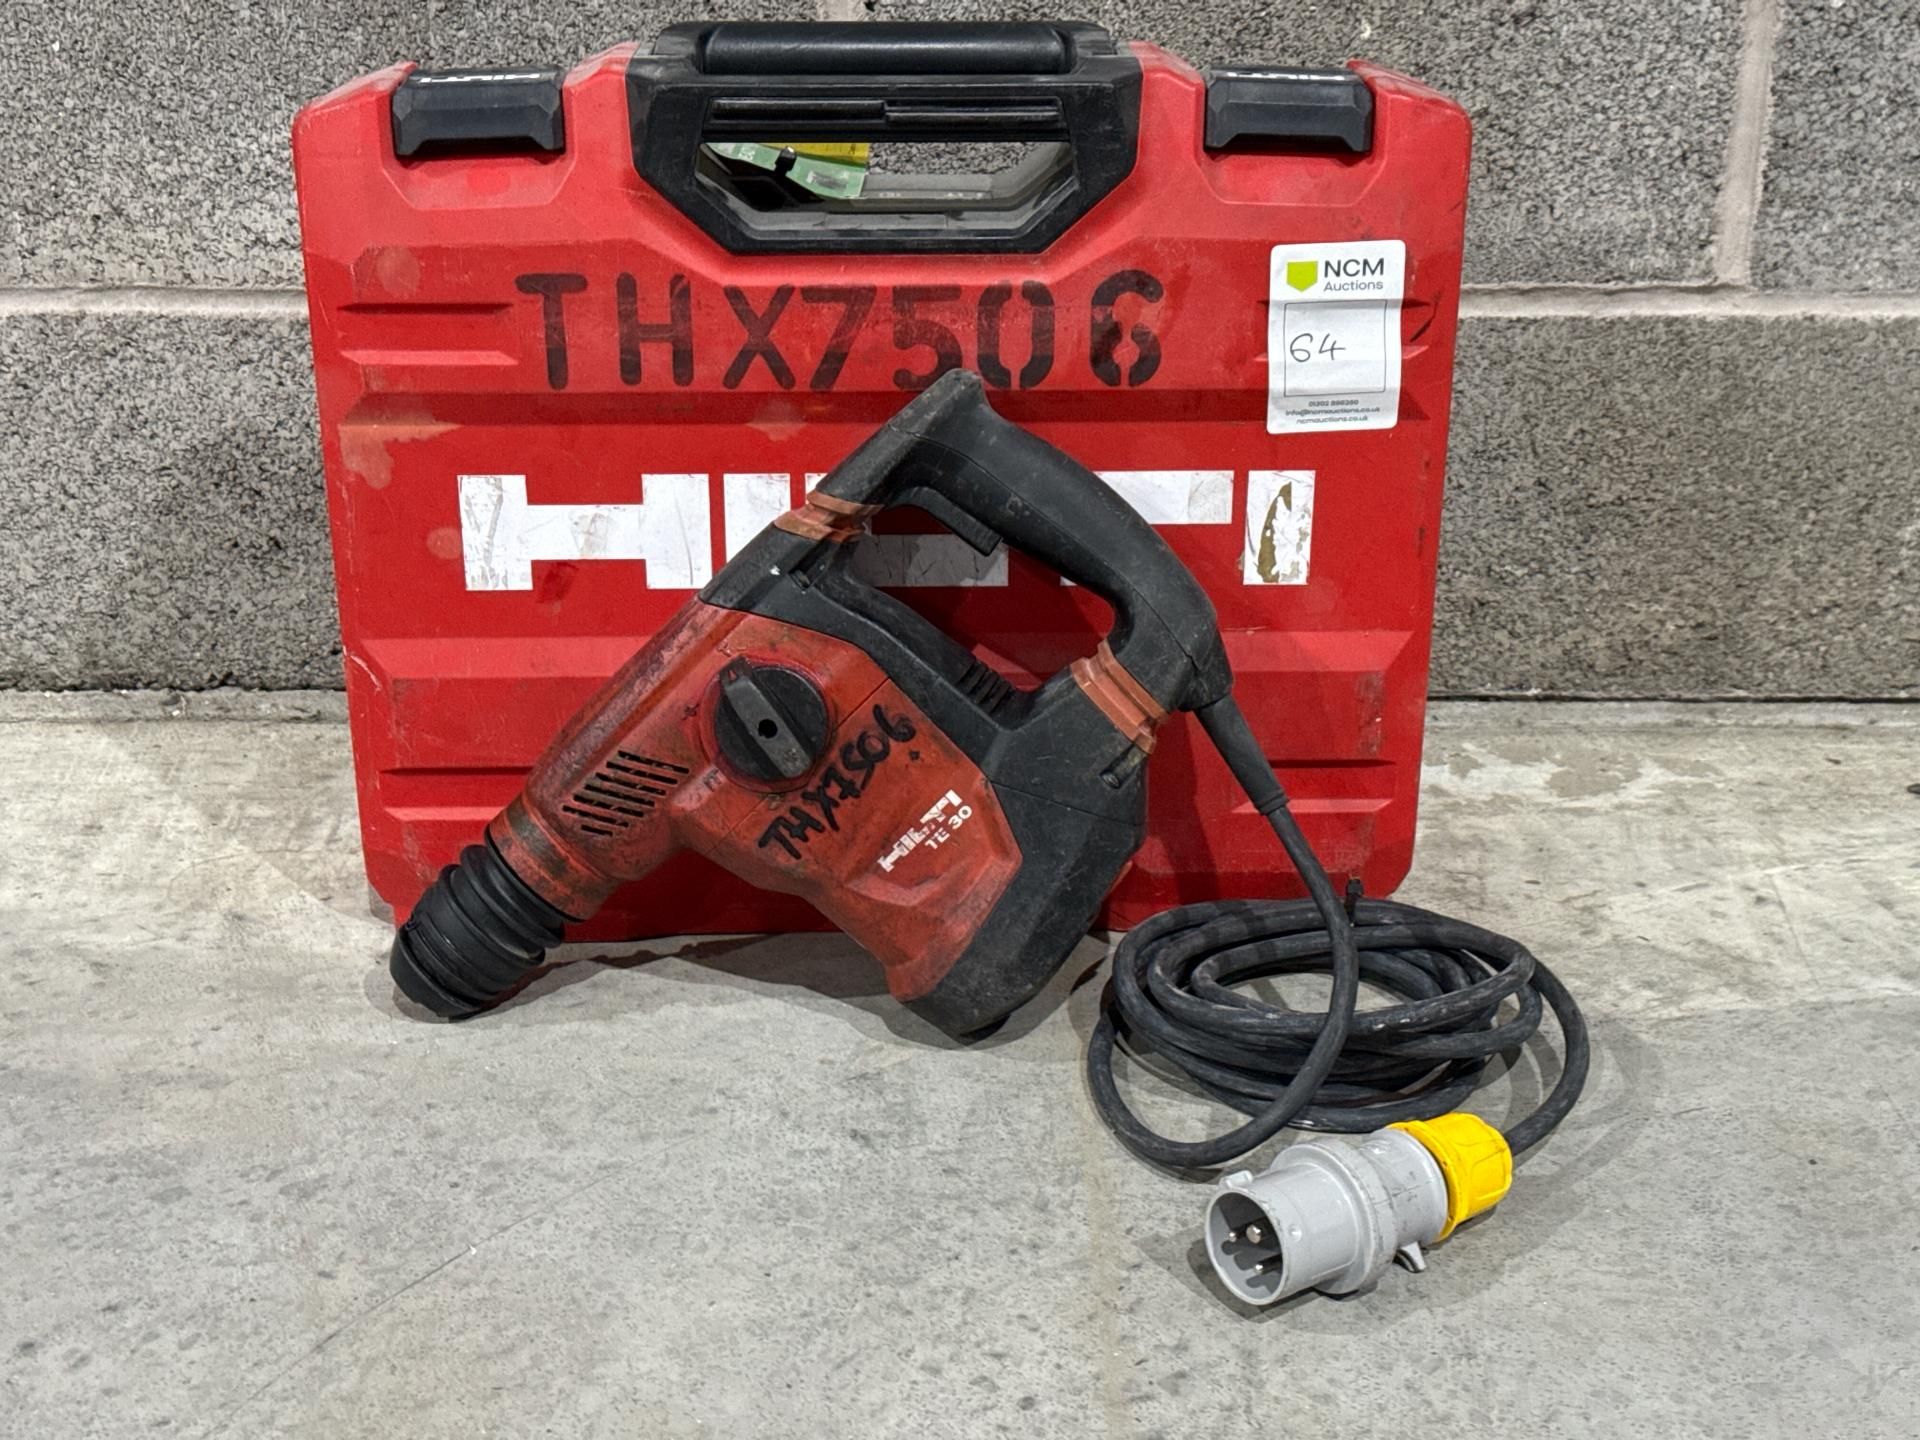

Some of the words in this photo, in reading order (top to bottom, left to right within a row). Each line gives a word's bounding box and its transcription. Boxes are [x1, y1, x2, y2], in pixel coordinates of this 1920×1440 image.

[1323, 280, 1384, 292] Auctions
[1324, 258, 1384, 278] NCM
[514, 269, 1164, 391] THX7506
[1289, 333, 1346, 362] 64
[758, 704, 916, 860] THX7506
[924, 827, 950, 849] TE
[948, 805, 973, 830] 30
